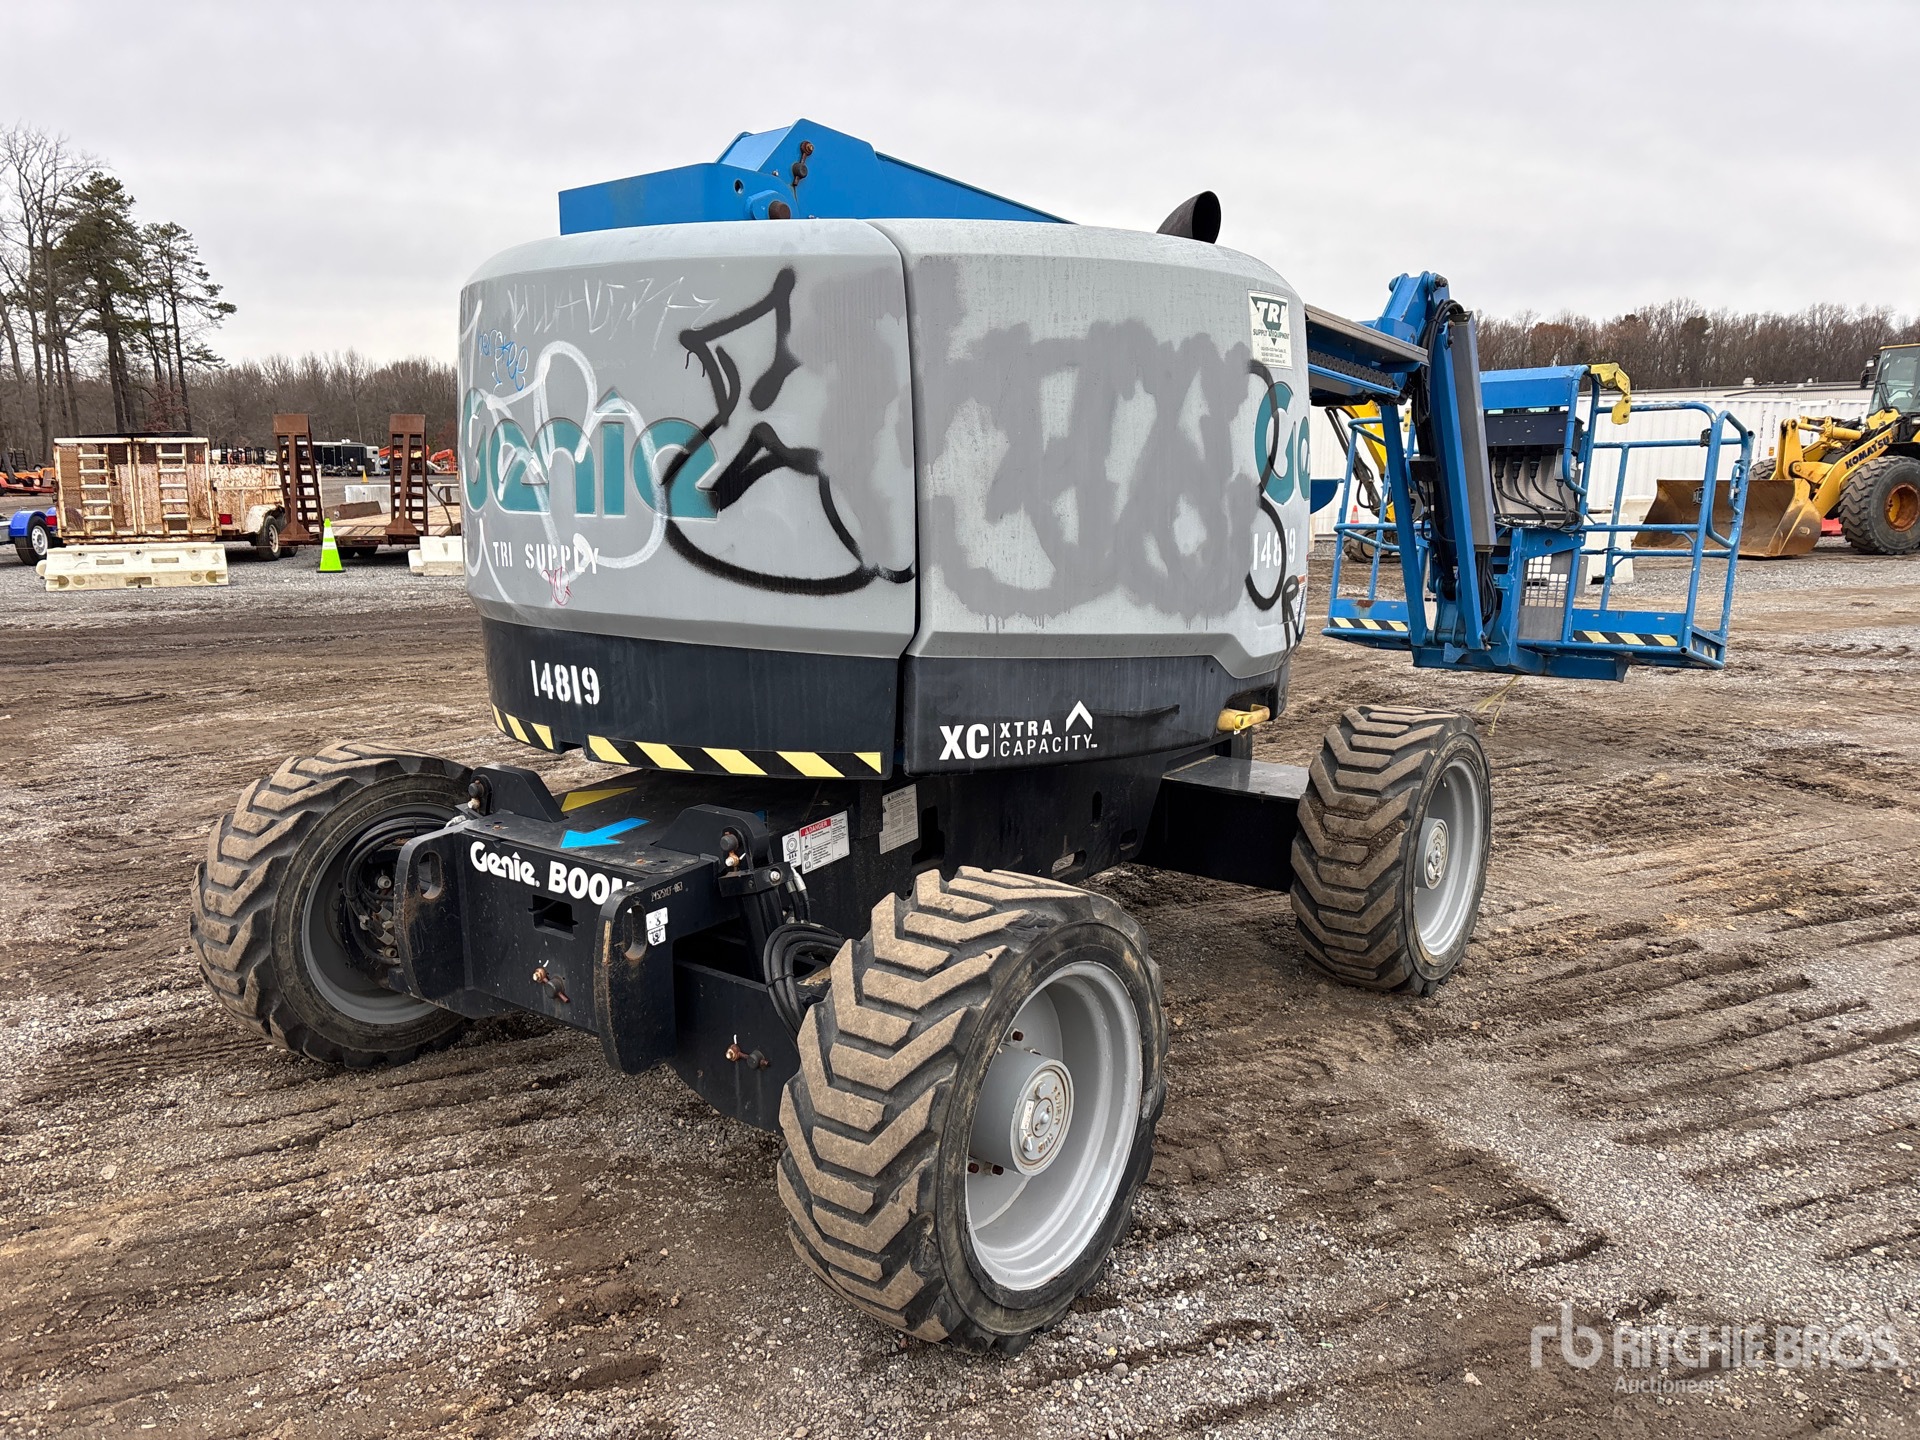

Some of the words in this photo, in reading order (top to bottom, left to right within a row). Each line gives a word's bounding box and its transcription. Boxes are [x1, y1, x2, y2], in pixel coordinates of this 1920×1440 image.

[1257, 301, 1287, 323] TRI
[463, 386, 719, 522] Genie
[1845, 435, 1890, 470] KOMATSU
[492, 541, 513, 567] TRI
[525, 543, 599, 575] SUPPLY
[1253, 527, 1296, 571] 1489
[531, 659, 599, 705] 14819
[939, 723, 989, 761] XC
[1000, 719, 1053, 739] XTRA
[1000, 733, 1093, 757] CAPACITY
[808, 819, 831, 834] DANGER
[470, 841, 535, 886] Genie
